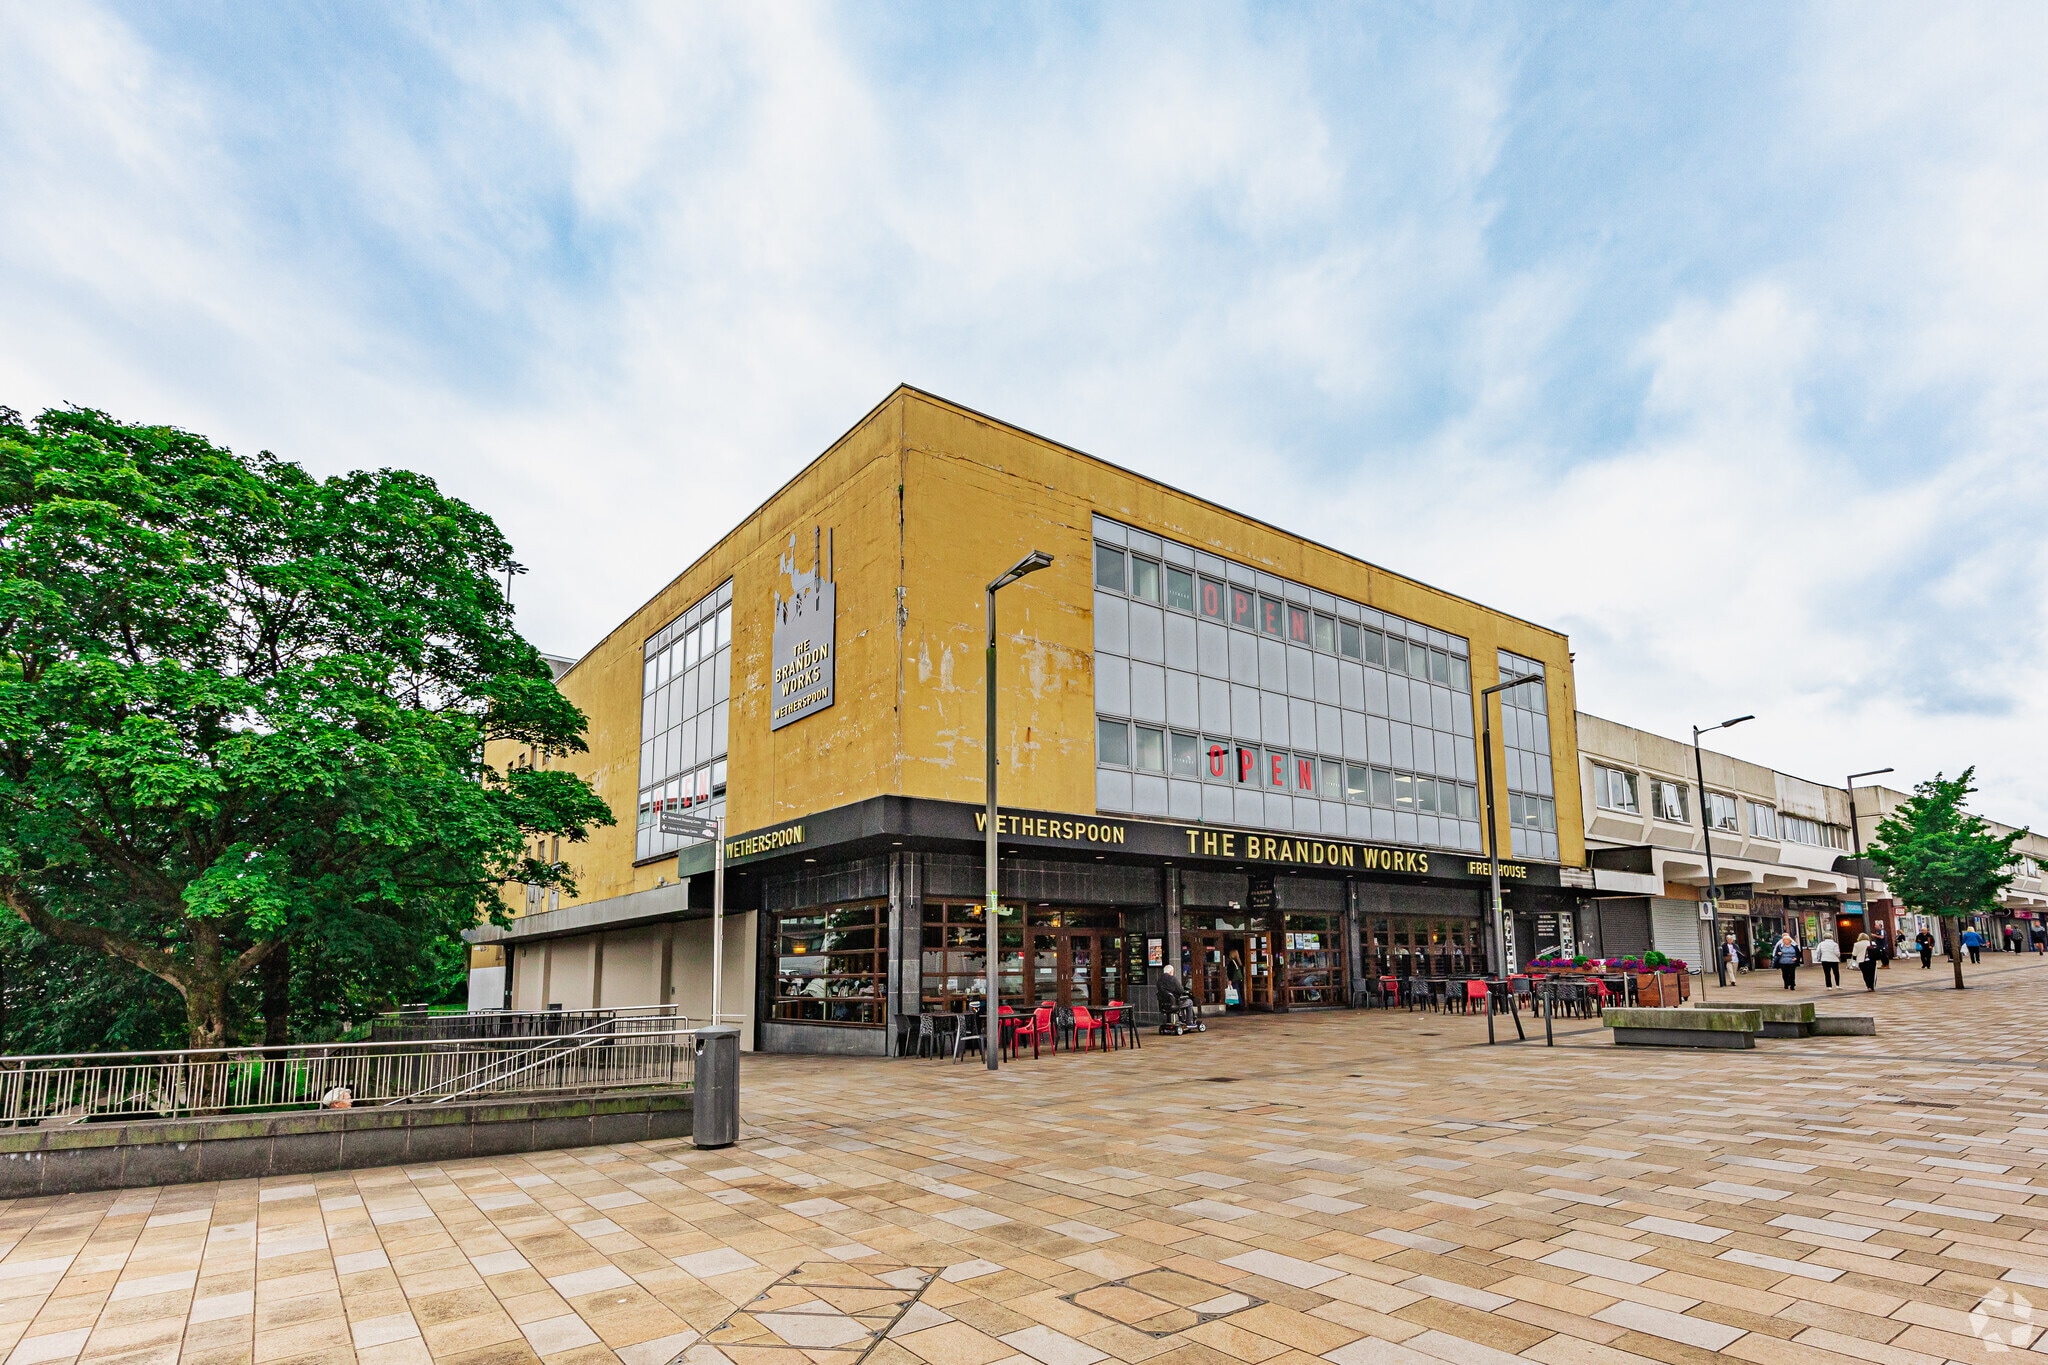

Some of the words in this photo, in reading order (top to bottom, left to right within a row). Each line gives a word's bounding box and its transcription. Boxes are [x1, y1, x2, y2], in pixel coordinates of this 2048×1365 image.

[1204, 583, 1305, 641] OPEN
[775, 643, 829, 683] BRANDON
[793, 640, 810, 657] THE
[782, 667, 820, 697] WORKS
[774, 687, 829, 720] WETHERSPOON
[1209, 744, 1312, 790] OPEN
[725, 825, 805, 859] WETHERSPOON
[974, 812, 1125, 844] WETHERSPOON
[1185, 829, 1235, 857] THE
[1246, 836, 1354, 867] BRANDON
[1363, 847, 1429, 873] WORKS
[1498, 864, 1527, 879] HOUSE
